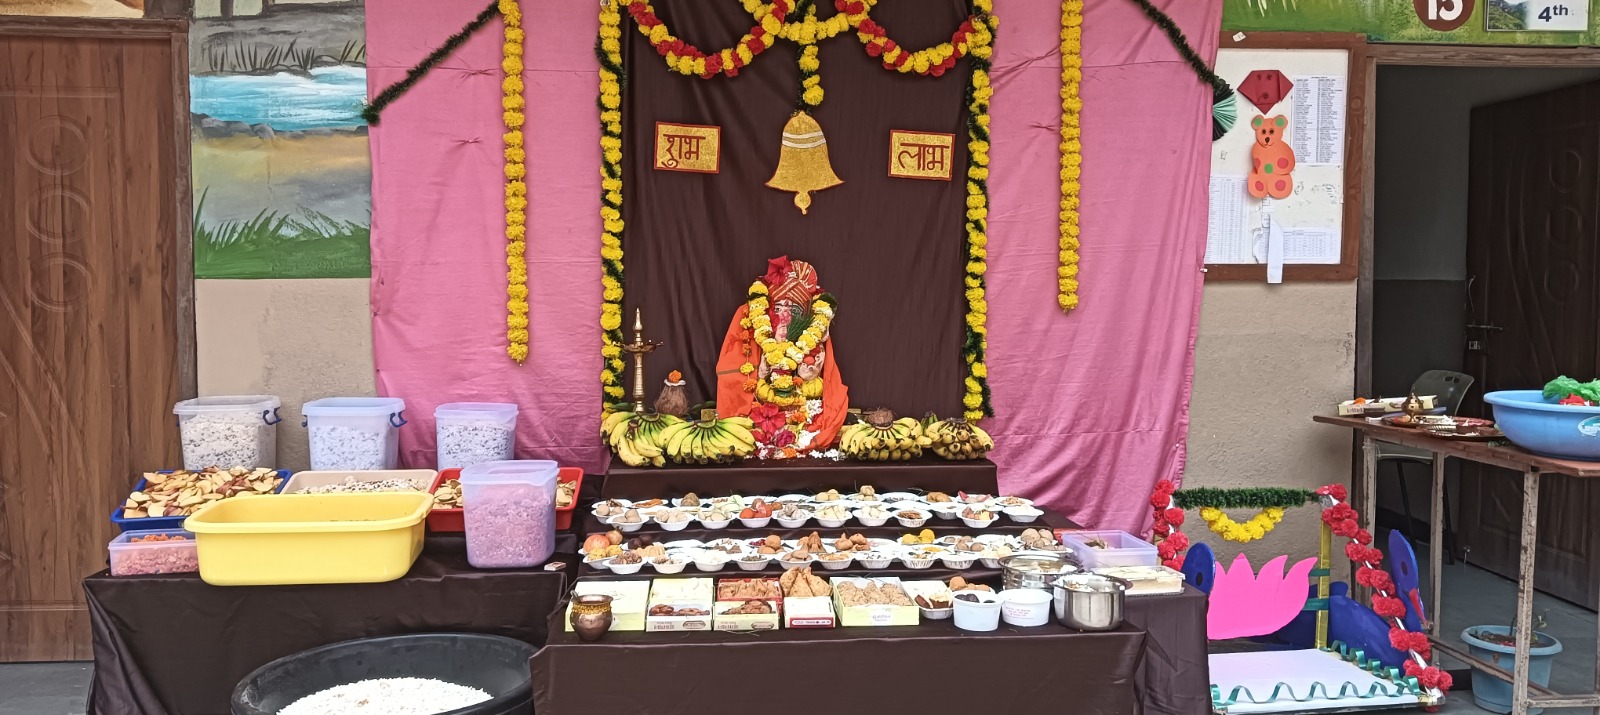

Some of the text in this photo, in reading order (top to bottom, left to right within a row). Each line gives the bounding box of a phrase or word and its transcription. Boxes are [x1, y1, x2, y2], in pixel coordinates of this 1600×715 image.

[1538, 5, 1569, 23] 4th
[662, 133, 706, 168] शुभ
[898, 142, 950, 171] लाभ
